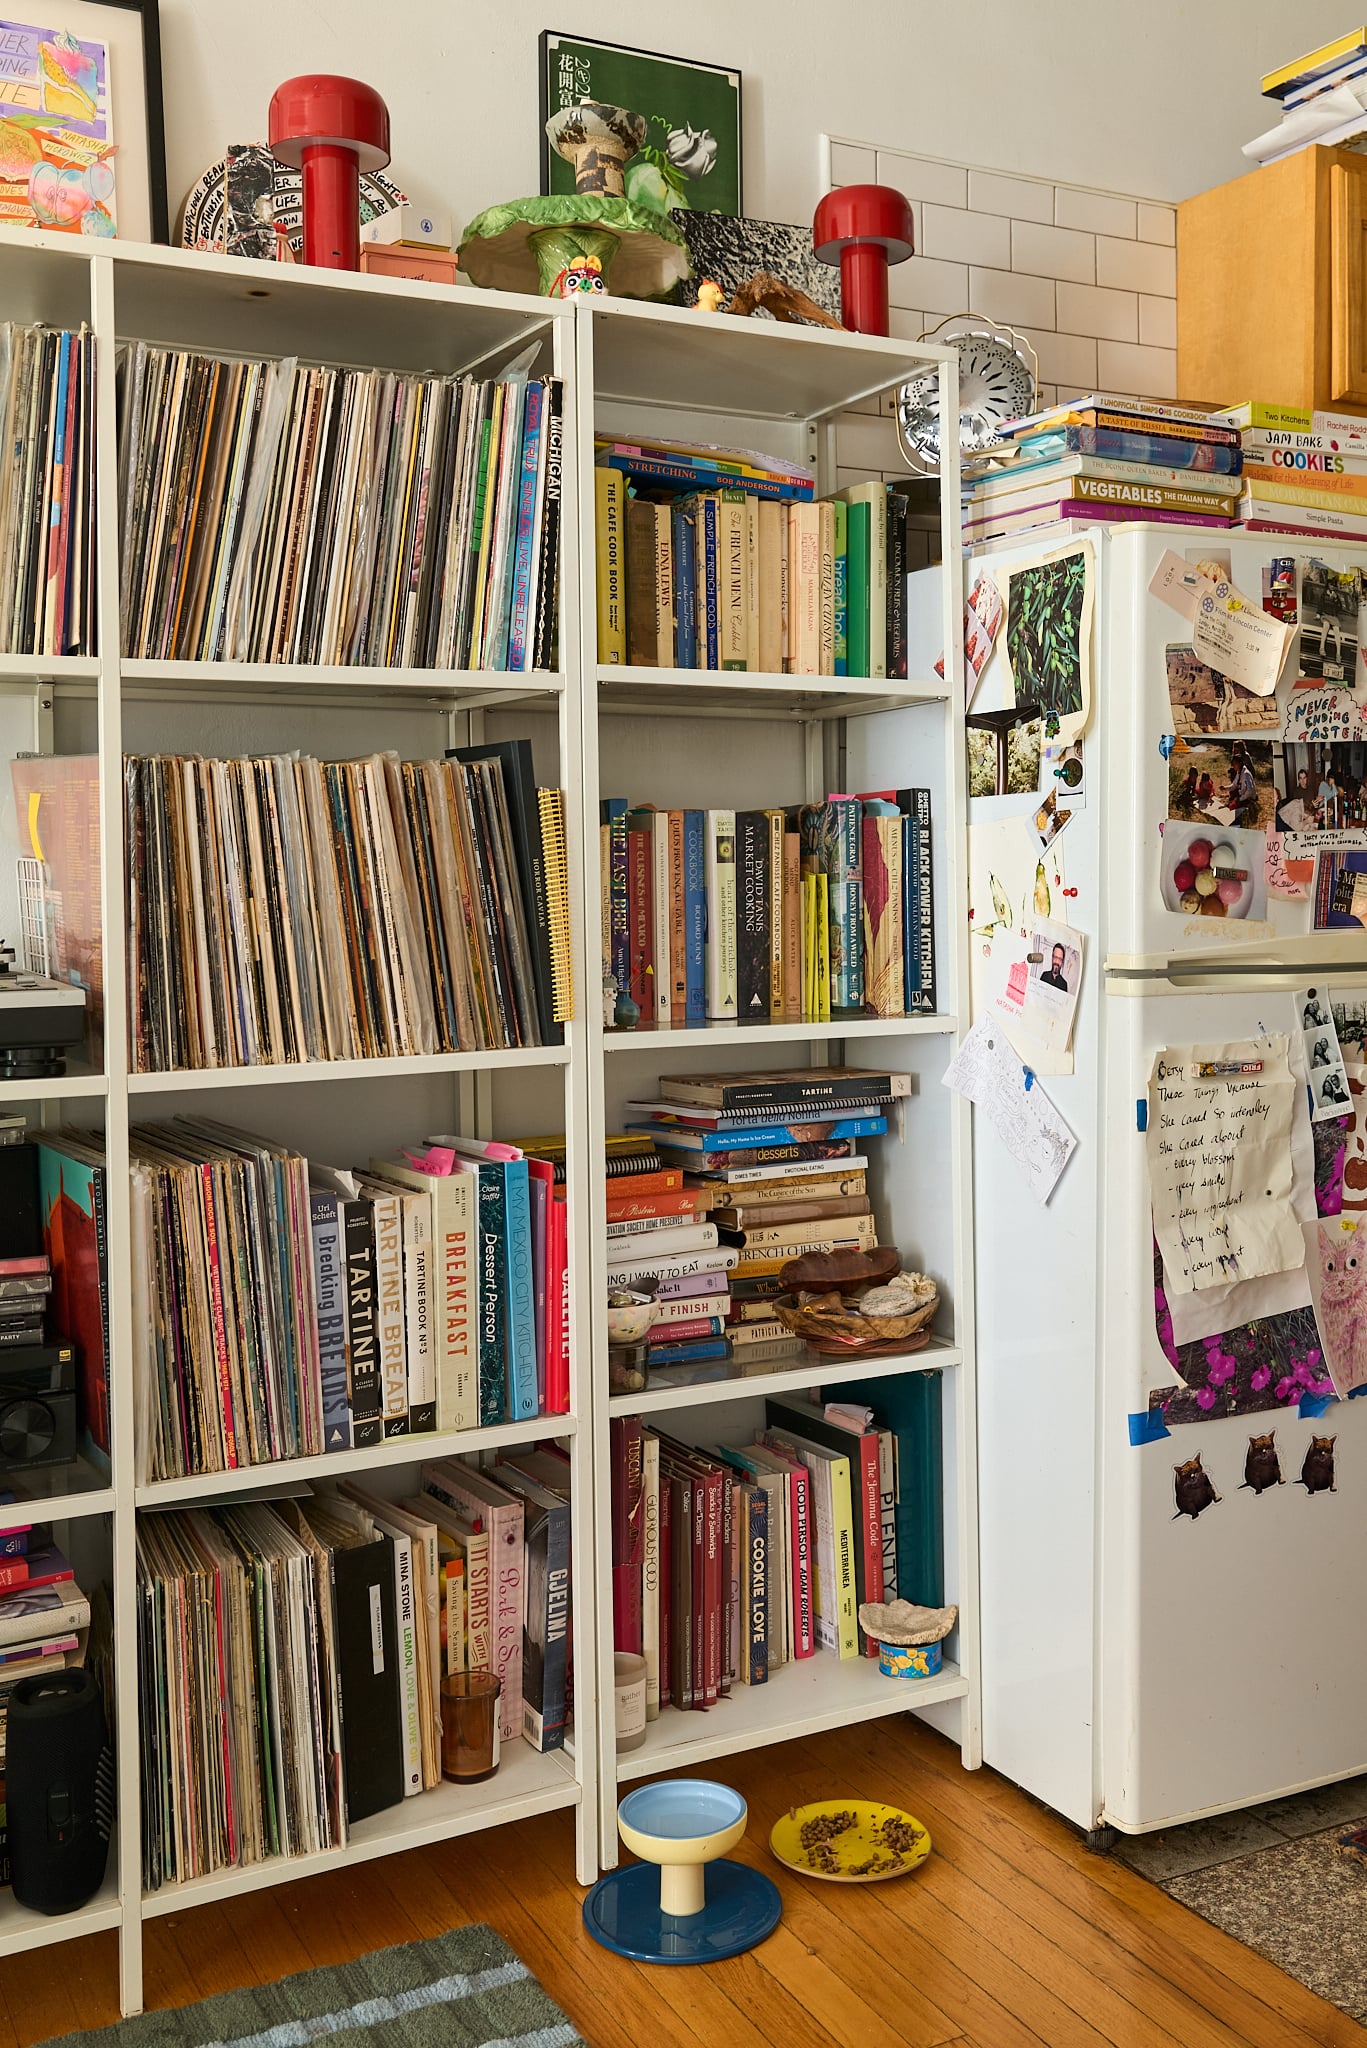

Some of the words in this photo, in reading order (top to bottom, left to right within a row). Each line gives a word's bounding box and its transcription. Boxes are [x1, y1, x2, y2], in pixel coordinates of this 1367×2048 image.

[558, 53, 574, 110] 花開富
[44, 143, 94, 165] PICKOWICZ
[62, 131, 108, 152] NATASHA
[527, 393, 539, 435] ROYAL
[1104, 400, 1139, 412] UNOFFICIAL
[1173, 409, 1208, 422] COOKBOOK
[1264, 411, 1279, 421] Two
[1280, 413, 1310, 426] Kitchens
[524, 439, 536, 474] TRUX
[548, 415, 563, 500] MICHIGAN
[1271, 449, 1345, 474] COOKIES
[607, 482, 616, 503] THE
[628, 461, 697, 480] STRETCHING
[716, 475, 737, 487] BOB
[738, 480, 780, 493] ANDERSON
[1078, 480, 1163, 504] VEGETABLES
[1164, 491, 1176, 500] THE
[1177, 493, 1203, 503] ITALIAN
[1203, 497, 1220, 506] WAY
[607, 506, 617, 533] CAFE
[706, 511, 714, 551] SIMPLE
[1306, 513, 1326, 524] Simple
[1327, 516, 1344, 526] Pasta
[608, 534, 618, 567] COOK
[661, 542, 669, 571] EDNA
[730, 530, 741, 575] FRENCH
[609, 569, 618, 600] BOOK
[662, 574, 670, 606] LEWIS
[730, 578, 742, 612] MENU
[834, 560, 846, 607] bread
[512, 574, 528, 665] UNRELEASED
[707, 598, 716, 629] FOOD
[1215, 606, 1228, 618] Film
[1233, 614, 1253, 631] Lincoln
[1253, 623, 1272, 638] Center
[731, 614, 743, 652] Cookbook
[834, 611, 846, 653] book
[1295, 696, 1337, 721] NEVER
[848, 804, 856, 840] PATIENCE
[688, 831, 697, 891] COOKBOOK
[745, 825, 754, 876] MARKET
[849, 841, 857, 864] GRAY
[919, 830, 932, 875] BLACK
[532, 858, 543, 894] HORROR
[755, 860, 764, 895] DAVID
[536, 895, 546, 928] CAVIAR
[727, 907, 734, 917] of
[745, 877, 754, 932] COOKING
[849, 884, 857, 912] HONEY
[920, 877, 932, 924] POWER
[727, 919, 735, 934] the
[756, 898, 764, 932] TANIS
[849, 913, 857, 936] FROM
[727, 935, 735, 979] artichoke
[850, 944, 858, 968] WEED
[920, 928, 933, 989] KITCHEN
[801, 1087, 833, 1096] TARTINE
[757, 1145, 799, 1161] desserts
[784, 1165, 809, 1174] EMOTIONAL
[809, 1164, 825, 1172] EATING
[481, 1185, 500, 1193] Claire
[512, 1186, 524, 1210] MY
[312, 1211, 337, 1221] Scheft
[317, 1204, 330, 1212] Uri
[379, 1200, 400, 1316] TARTINE
[484, 1233, 498, 1289] Dessert
[512, 1216, 529, 1278] MEXICO
[318, 1235, 338, 1311] Breaking
[667, 1267, 680, 1278] TO
[682, 1260, 699, 1275] EAT
[446, 1231, 468, 1356] BREAKFAST
[516, 1283, 532, 1318] CITY
[756, 1282, 780, 1293] When
[349, 1248, 374, 1376] TARTINE
[485, 1293, 498, 1342] Person
[670, 1302, 709, 1316] FINISH
[751, 1326, 778, 1339] PATRICIA
[318, 1314, 348, 1414] BREADS
[383, 1324, 404, 1410] BREAD
[518, 1324, 536, 1388] KITCHEN
[628, 1437, 641, 1489] TUSCANY
[867, 1460, 877, 1478] The
[682, 1491, 691, 1513] Cakes
[708, 1487, 717, 1512] Snacks
[867, 1480, 880, 1520] Jemima
[646, 1495, 658, 1555] GLORIOUS
[708, 1520, 717, 1560] Sandwiches
[797, 1519, 807, 1560] PERSON
[869, 1521, 880, 1547] Code
[399, 1552, 411, 1582] MINA
[646, 1557, 658, 1591] FOOD
[751, 1537, 765, 1597] COOKIE
[840, 1529, 850, 1589] MEDITERRANEA
[451, 1580, 459, 1610] Saving
[799, 1568, 808, 1595] ADAM
[401, 1584, 411, 1621] STONE
[547, 1568, 568, 1643] GJELINA
[800, 1597, 809, 1637] ROBERTS
[752, 1607, 765, 1643] LOVE
[403, 1627, 414, 1670] LEMON,
[405, 1670, 416, 1700] LOVE
[620, 1690, 641, 1702] gather
[407, 1701, 416, 1710] &
[407, 1712, 418, 1745] OLIVE
[409, 1747, 419, 1765] OIL
